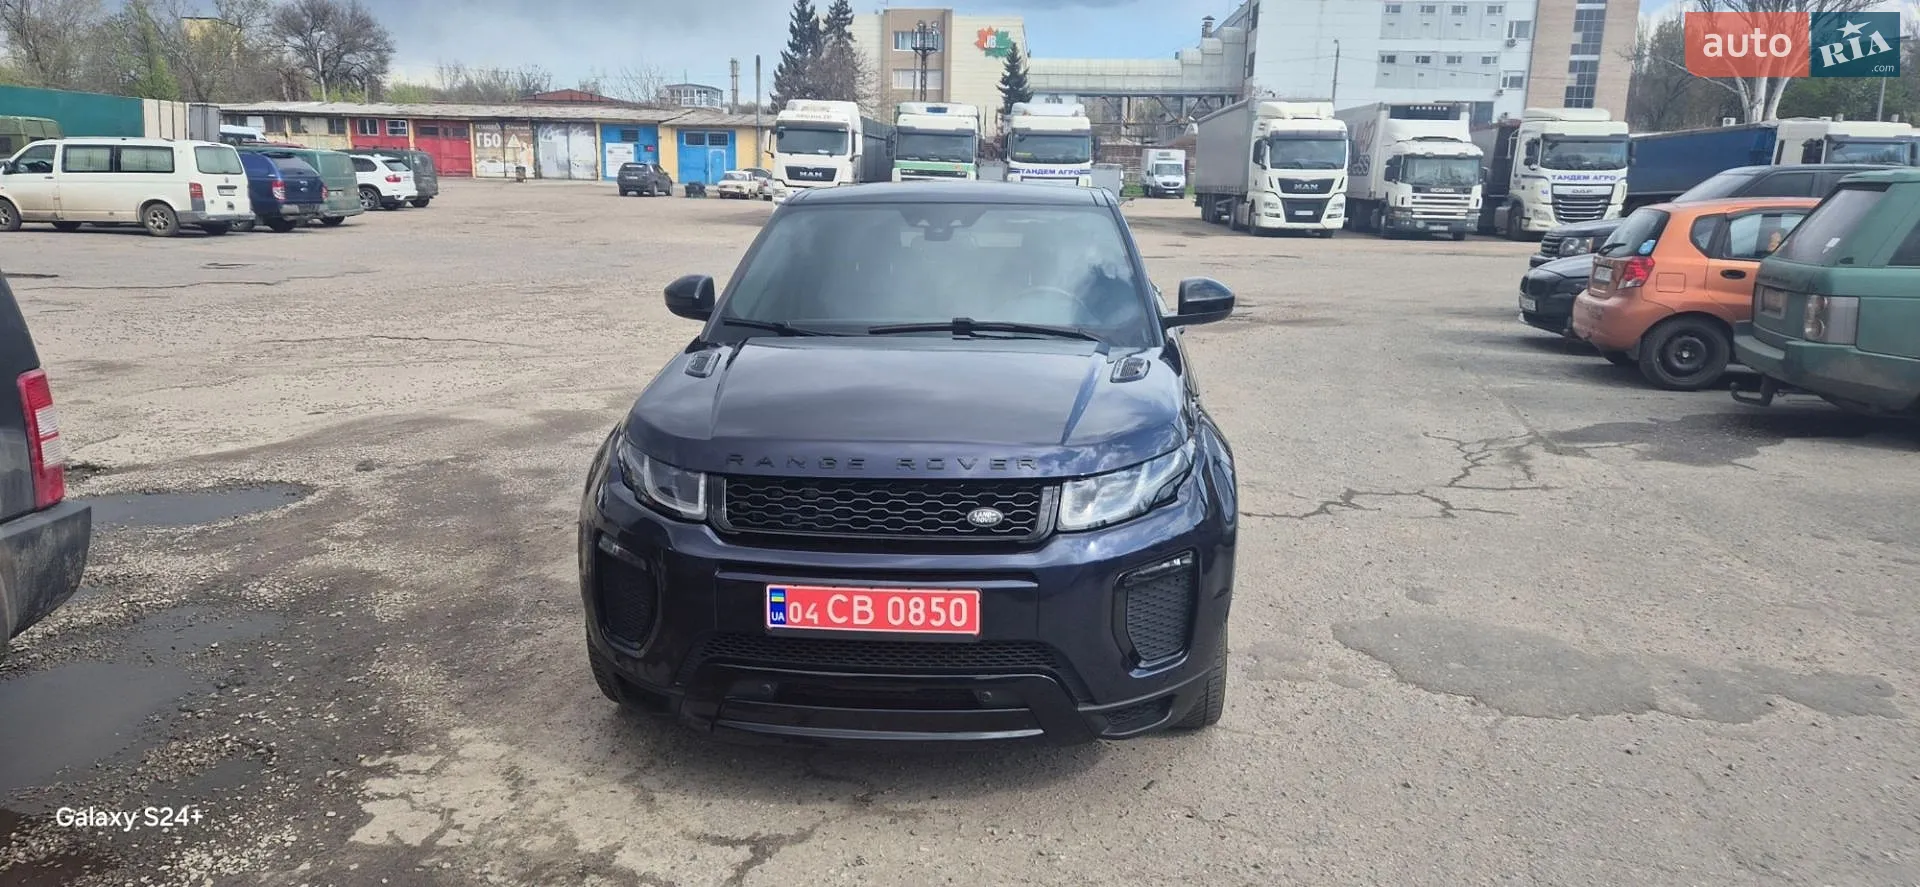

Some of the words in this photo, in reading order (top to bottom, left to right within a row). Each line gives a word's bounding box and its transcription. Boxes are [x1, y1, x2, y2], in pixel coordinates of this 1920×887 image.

[476, 132, 501, 148] ГБО
[1020, 168, 1056, 176] ТАНДЕМ
[725, 453, 868, 470] RANGE
[896, 456, 1037, 472] ROVER
[771, 611, 785, 622] UA
[788, 601, 819, 625] 04
[826, 593, 875, 625] CB
[886, 595, 968, 628] 0850
